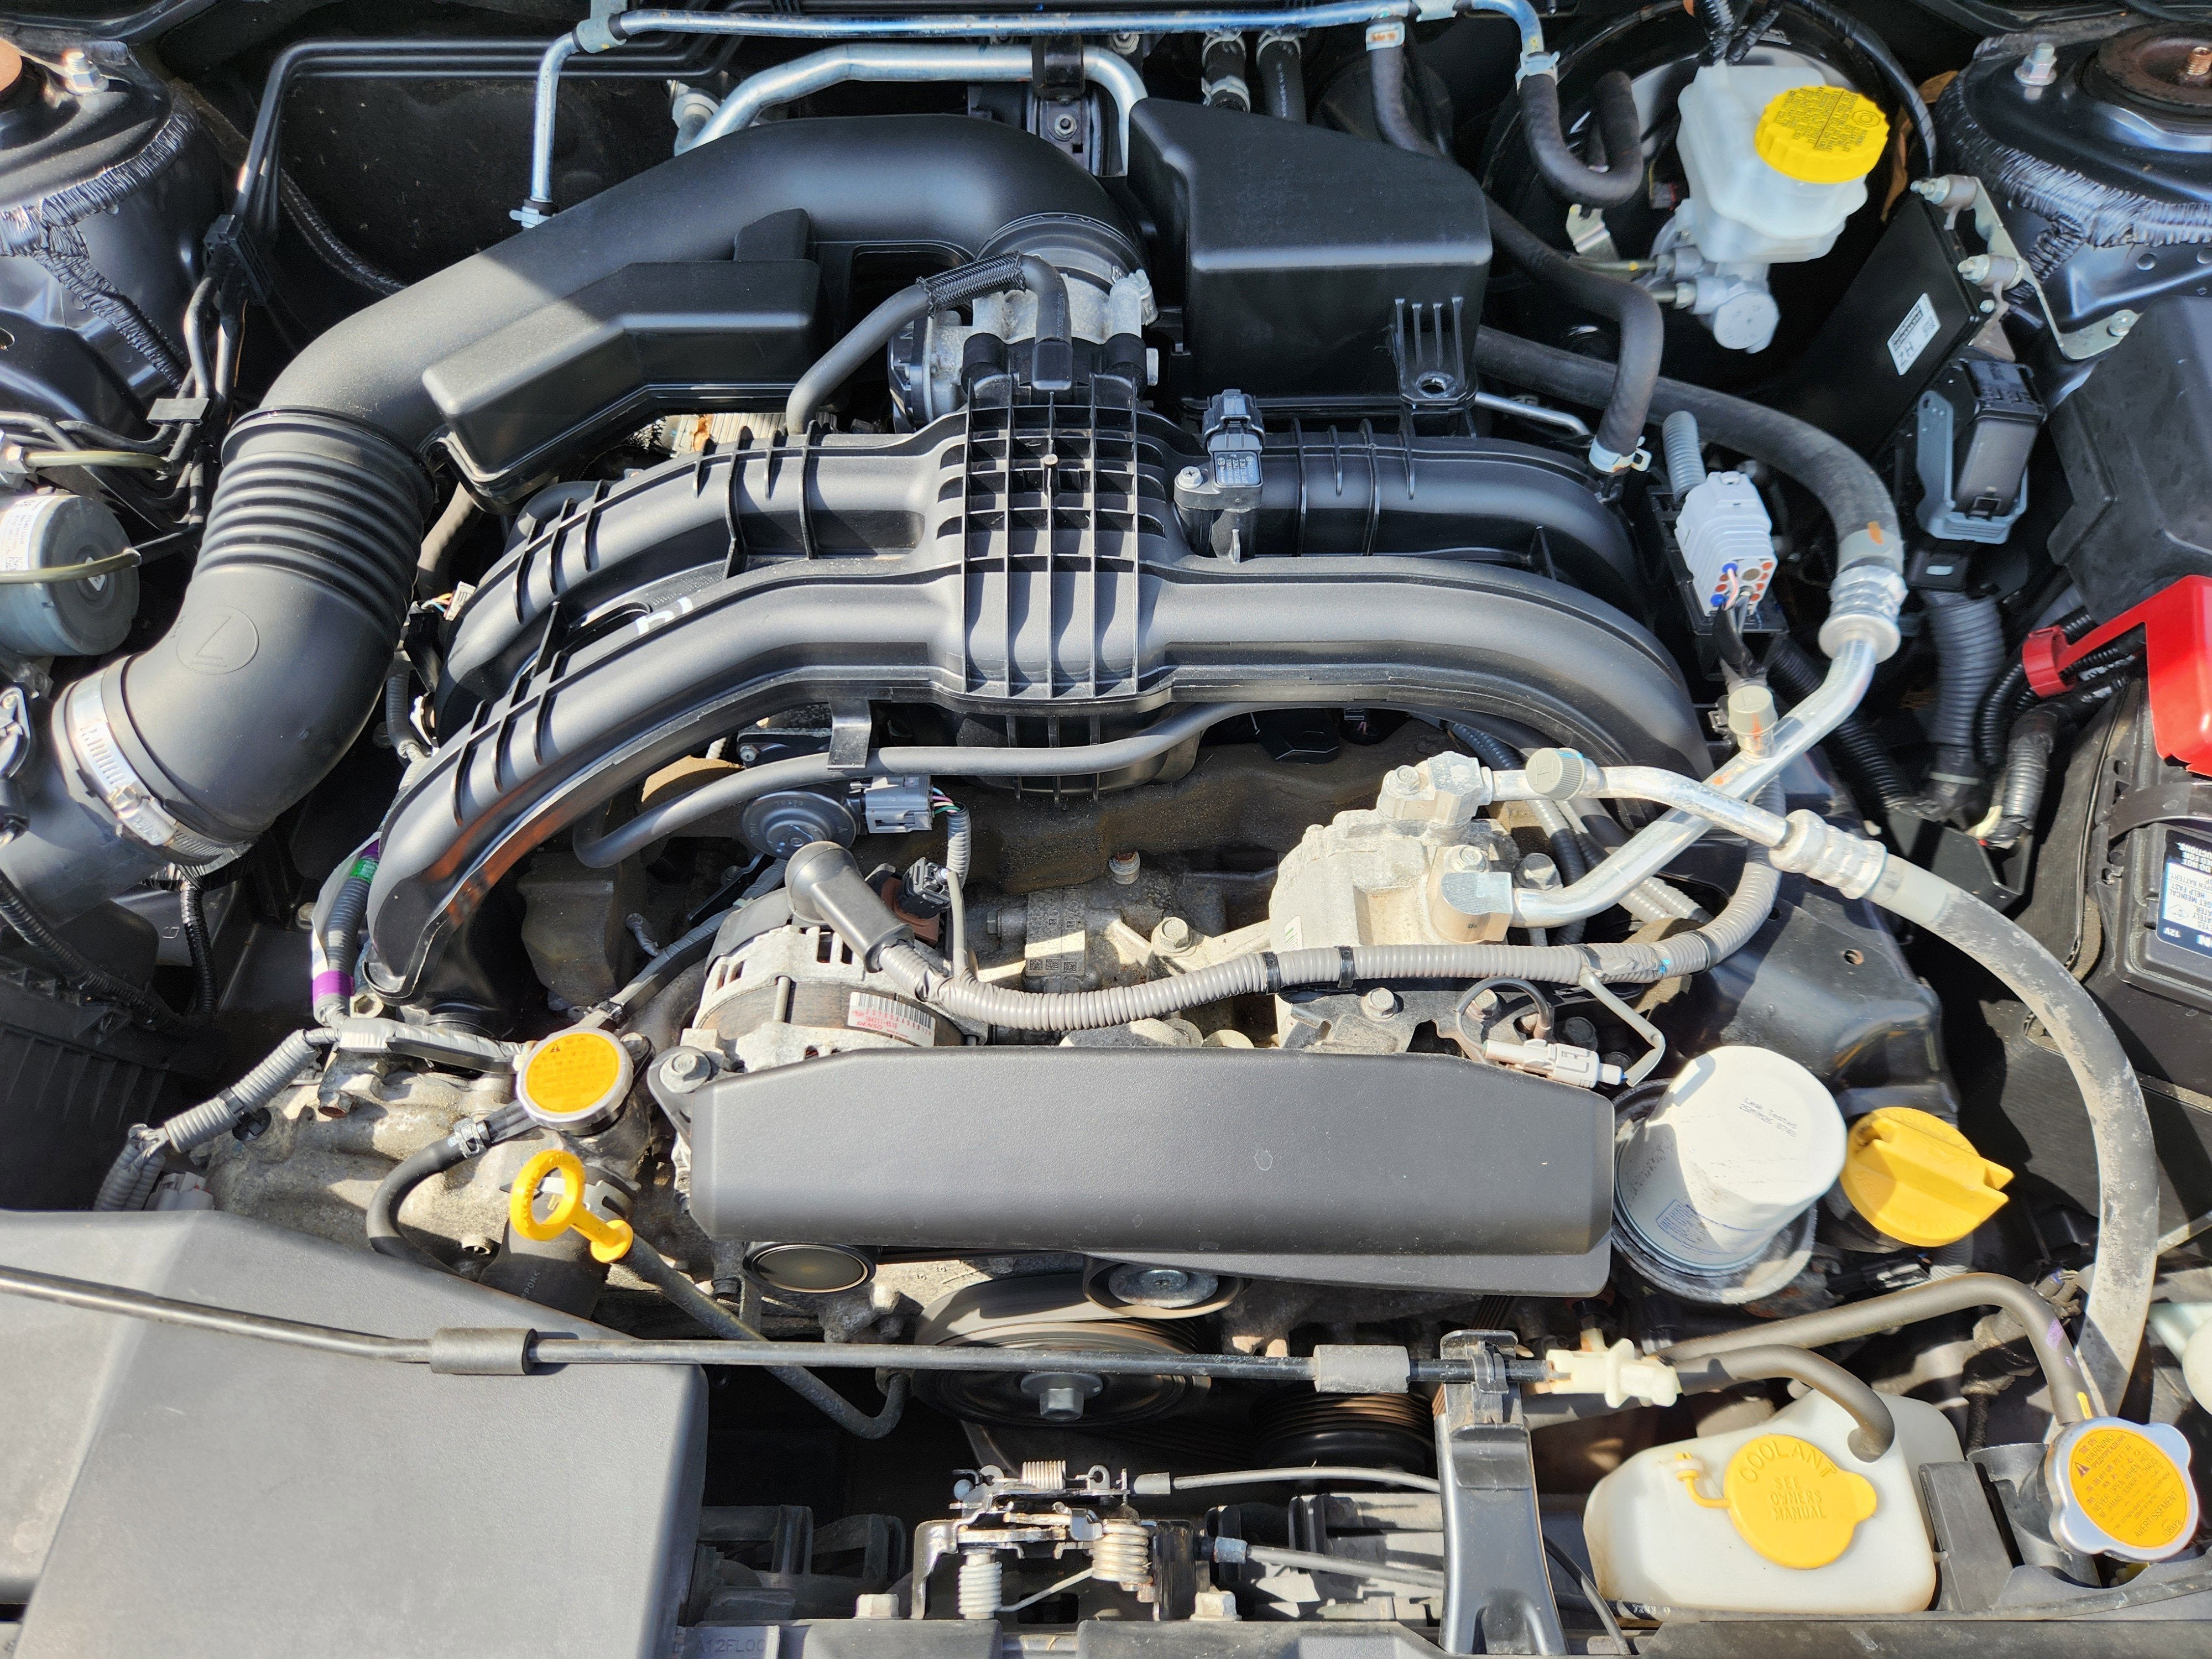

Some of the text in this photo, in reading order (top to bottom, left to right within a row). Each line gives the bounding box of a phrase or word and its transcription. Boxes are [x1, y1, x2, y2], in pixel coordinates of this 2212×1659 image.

[1533, 755, 1554, 786] H
[2181, 851, 2199, 862] FOR
[2182, 858, 2199, 869] NOT
[2169, 888, 2197, 904] MEDICAL
[2188, 889, 2205, 899] HELP
[2163, 927, 2182, 938] 12V
[857, 1020, 883, 1030] DENSO
[1745, 1097, 1797, 1129] Leak Tested
[2085, 1432, 2115, 1463] WARNING
[1740, 1440, 1838, 1483] COOLANT
[1774, 1475, 1801, 1489] SEE
[2093, 1494, 2112, 1513] NEVER
[2111, 1479, 2125, 1495] OPEN
[2125, 1463, 2141, 1480] WHEN
[1770, 1490, 1822, 1505] OWNERS
[1773, 1504, 1827, 1521] MANUAL
[2134, 1490, 2179, 1538] AVERTISSEMENT
